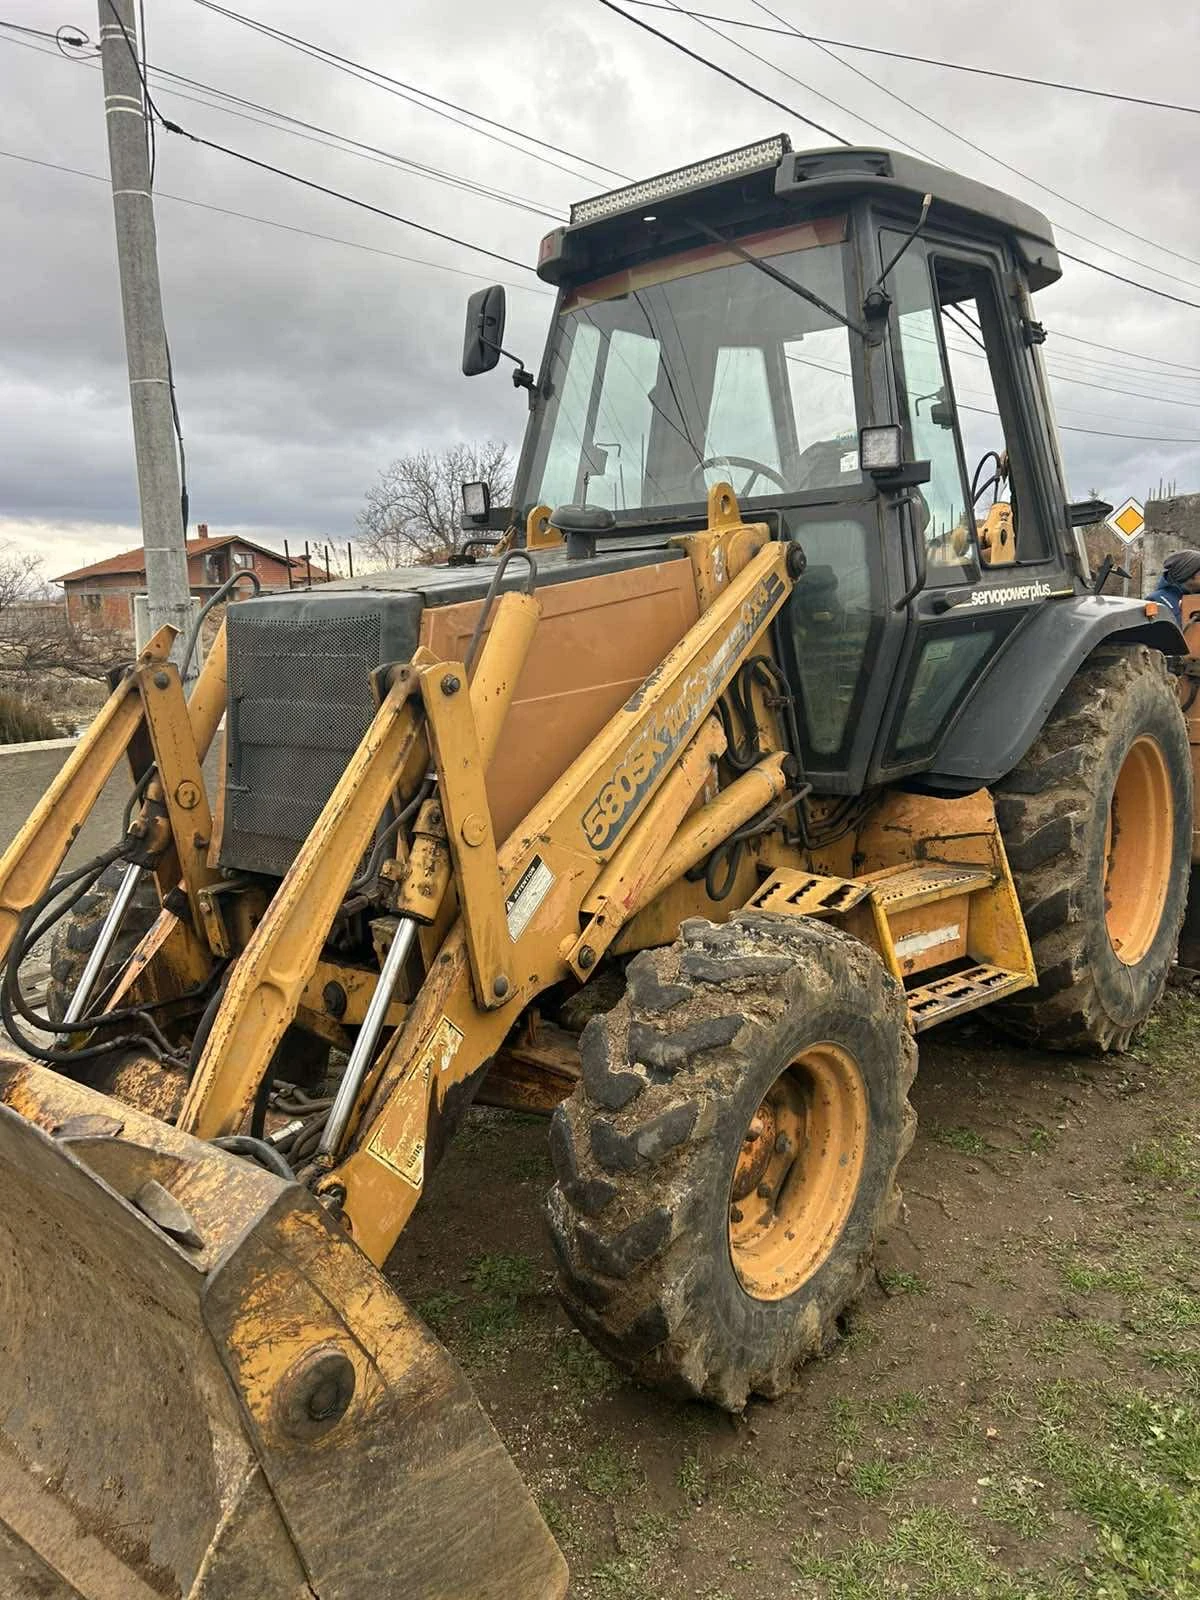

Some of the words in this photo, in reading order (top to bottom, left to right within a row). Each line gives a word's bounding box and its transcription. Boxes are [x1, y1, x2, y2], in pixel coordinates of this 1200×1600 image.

[970, 580, 1051, 606] servopowerplus
[582, 722, 669, 848] 580SK
[513, 866, 536, 899] ATTENTION
